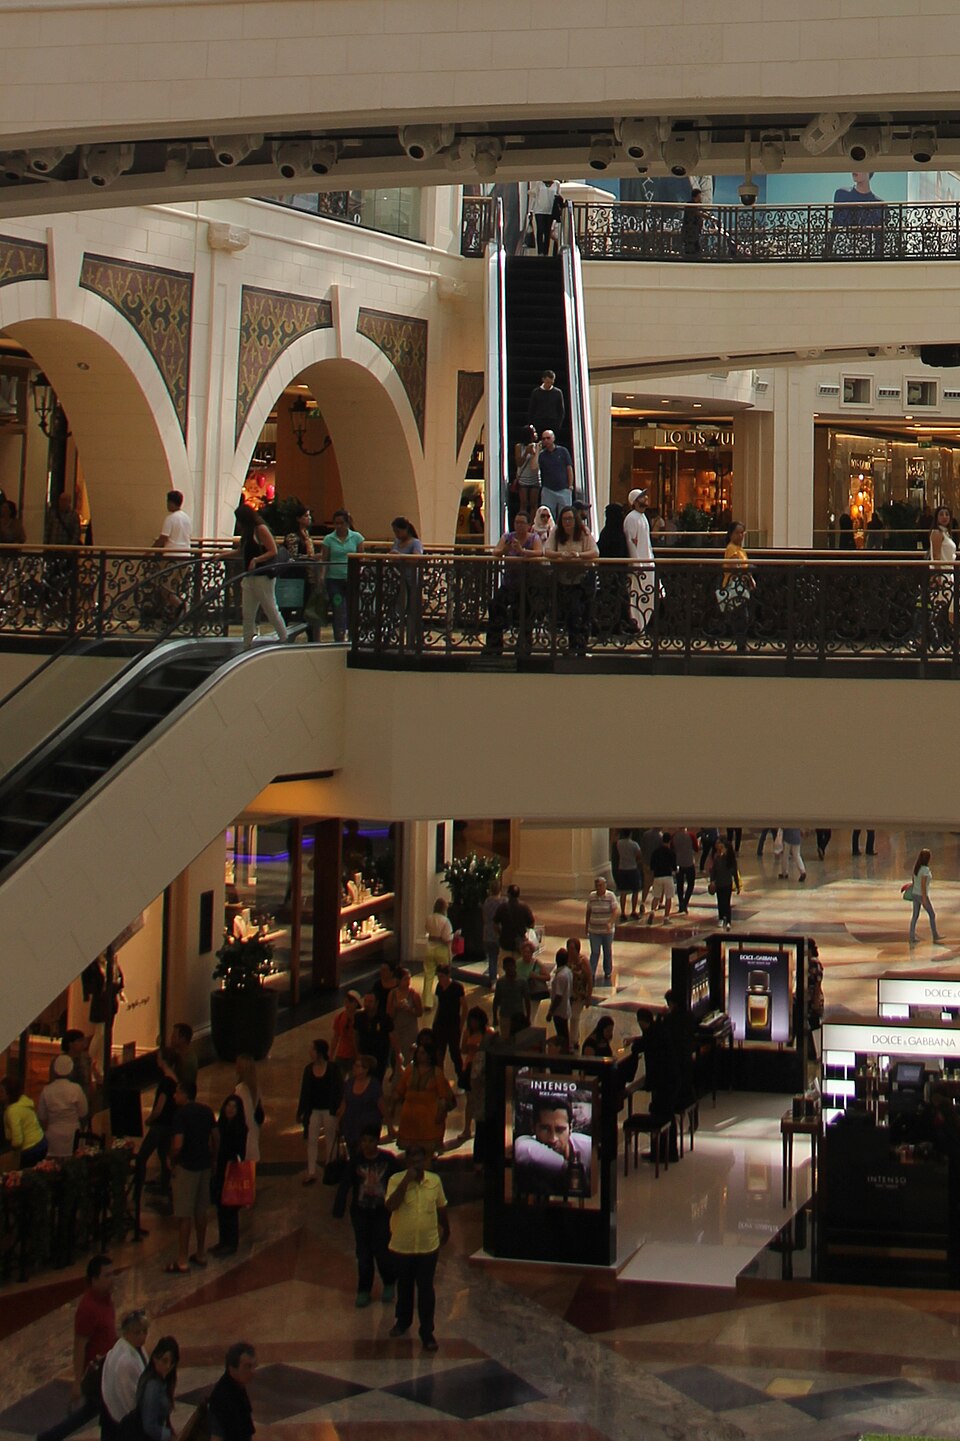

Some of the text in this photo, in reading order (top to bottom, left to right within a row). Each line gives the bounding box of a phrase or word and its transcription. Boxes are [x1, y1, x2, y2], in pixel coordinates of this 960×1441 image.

[663, 430, 706, 445] LOUIS
[924, 988, 952, 998] DOLCE
[872, 1034, 902, 1045] DOLCE
[908, 1036, 956, 1048] GABBANA
[530, 1080, 577, 1092] INTENSO
